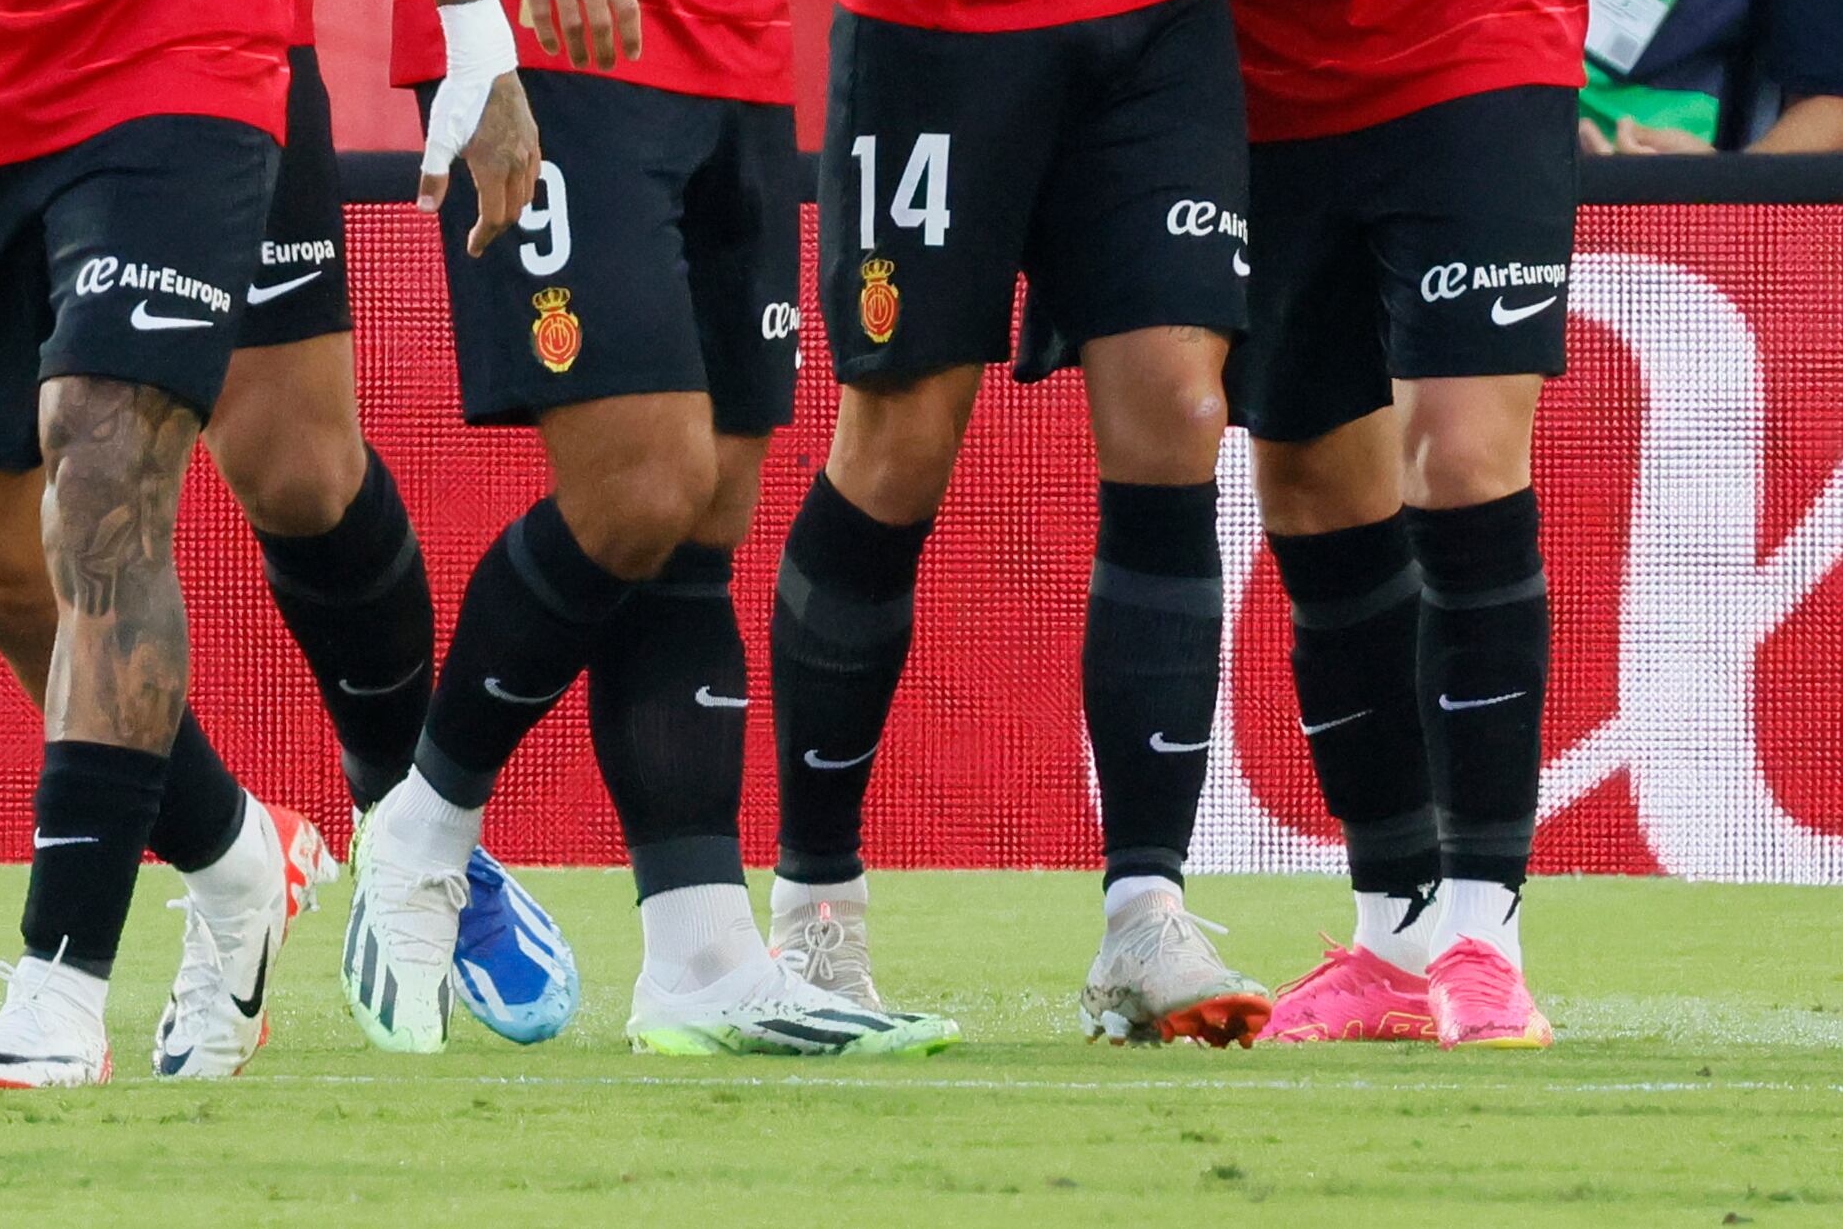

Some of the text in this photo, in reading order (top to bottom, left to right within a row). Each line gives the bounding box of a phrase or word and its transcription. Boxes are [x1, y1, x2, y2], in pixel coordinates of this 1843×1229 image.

[518, 160, 571, 276] 9
[851, 133, 951, 249] 14
[119, 263, 231, 312] AirEuropa
